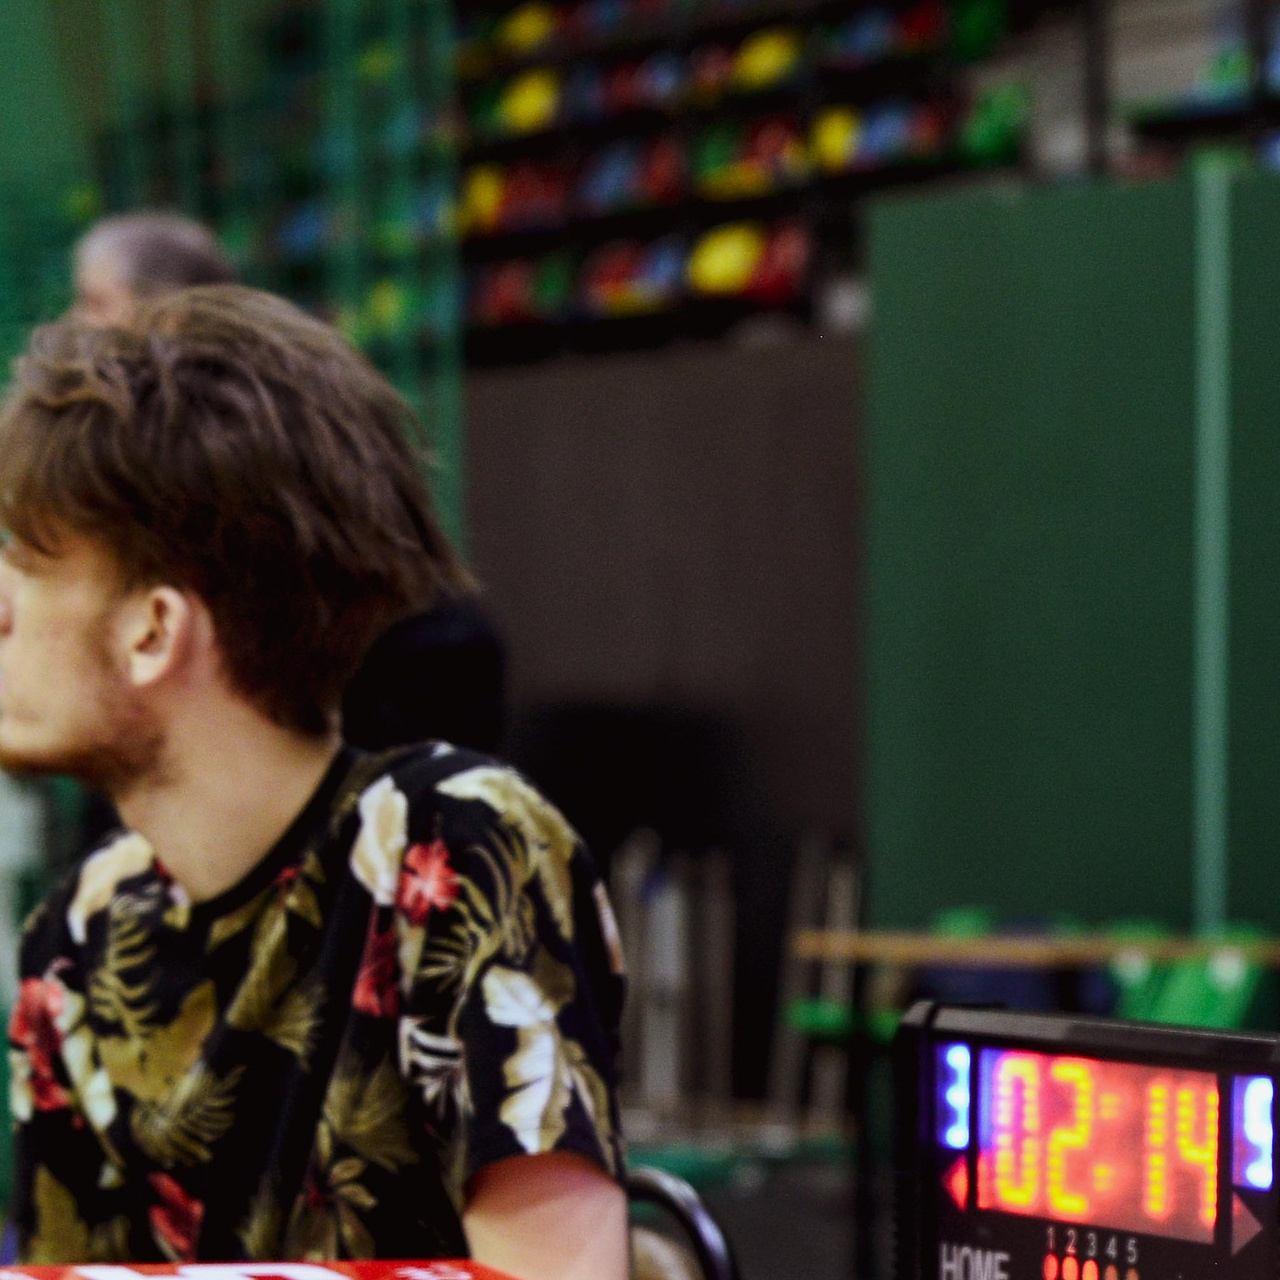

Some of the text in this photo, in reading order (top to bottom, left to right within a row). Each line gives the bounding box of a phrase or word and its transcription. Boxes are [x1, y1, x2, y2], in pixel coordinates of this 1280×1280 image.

[1066, 1228, 1077, 1254] 2
[1086, 1232, 1097, 1257] 3
[1106, 1236, 1118, 1259] 4
[1126, 1238, 1138, 1264] 5
